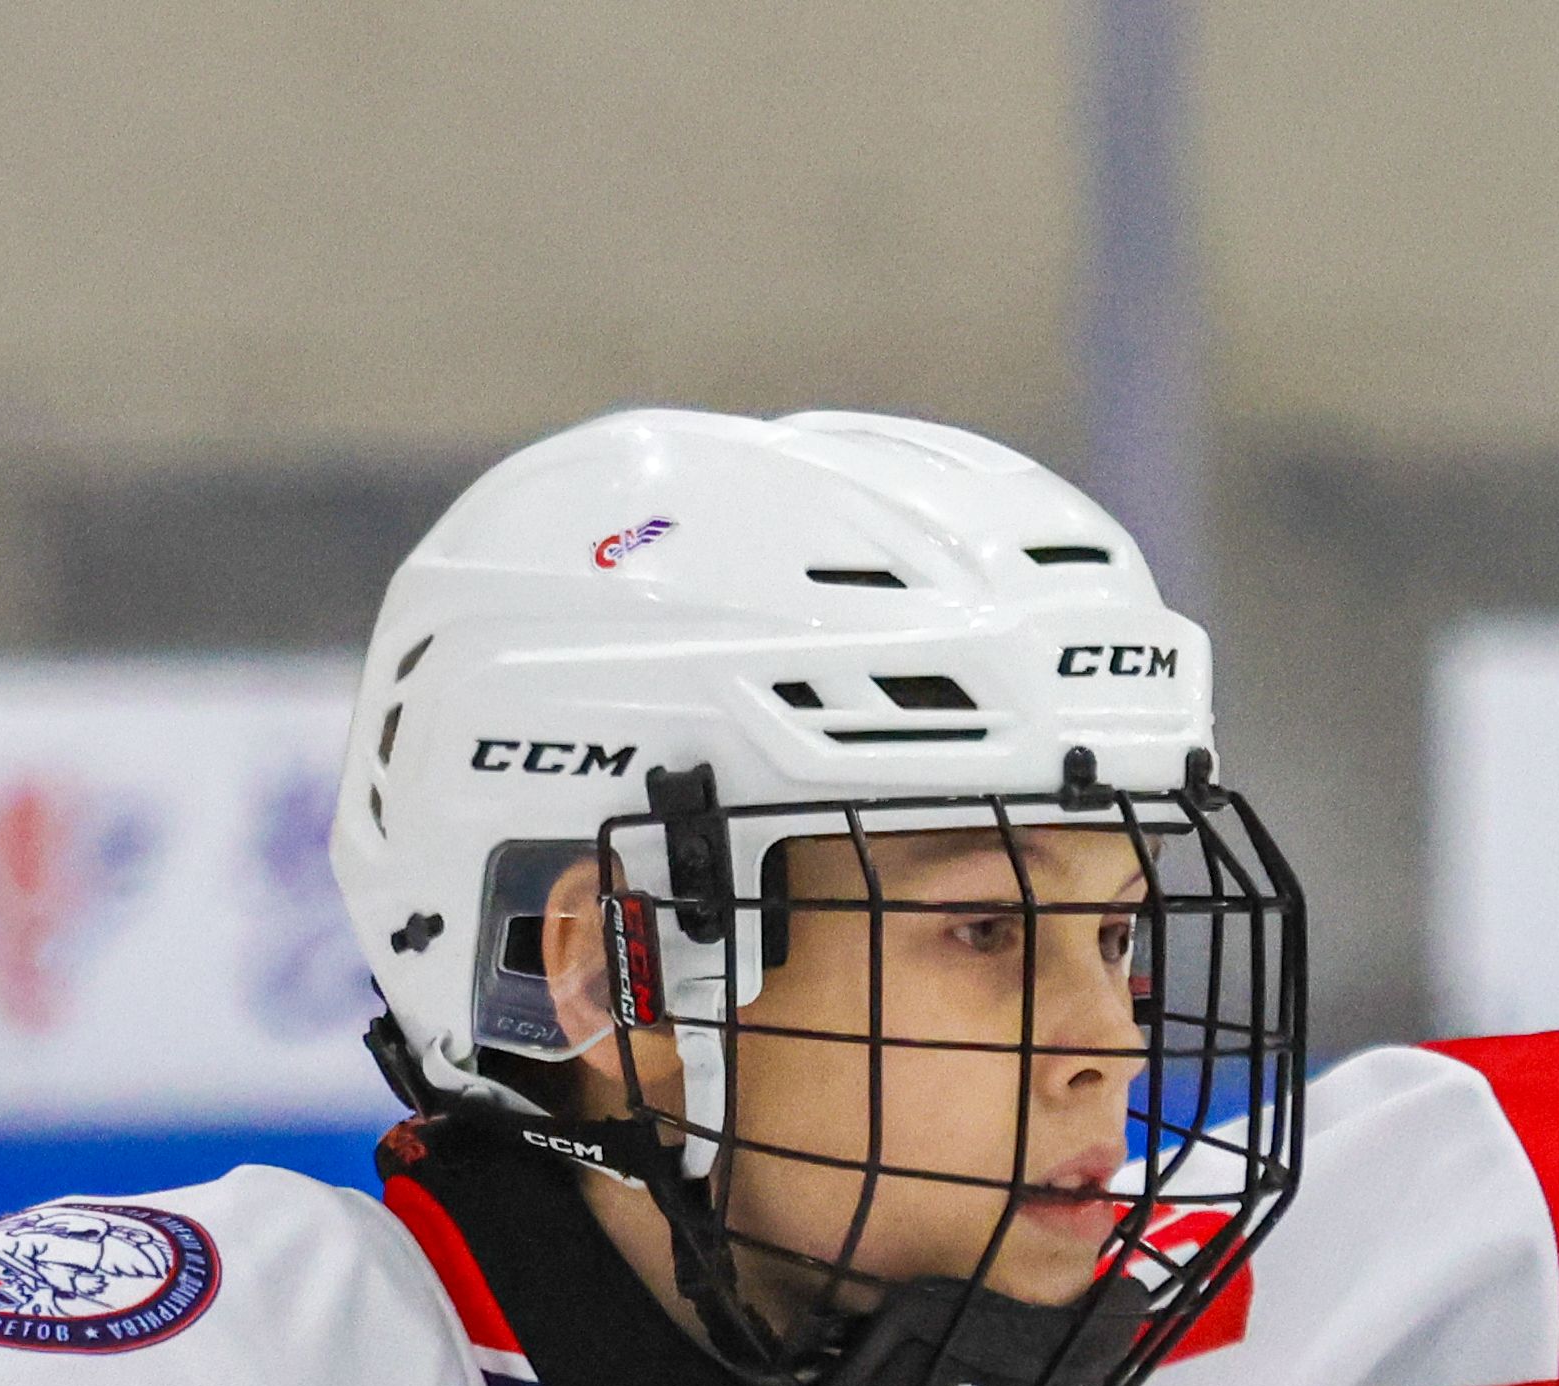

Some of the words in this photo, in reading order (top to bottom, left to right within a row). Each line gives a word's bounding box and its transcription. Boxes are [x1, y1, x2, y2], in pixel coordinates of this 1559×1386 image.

[1056, 644, 1179, 679] CCM
[471, 738, 638, 777] CCM
[522, 1130, 604, 1162] CCM
